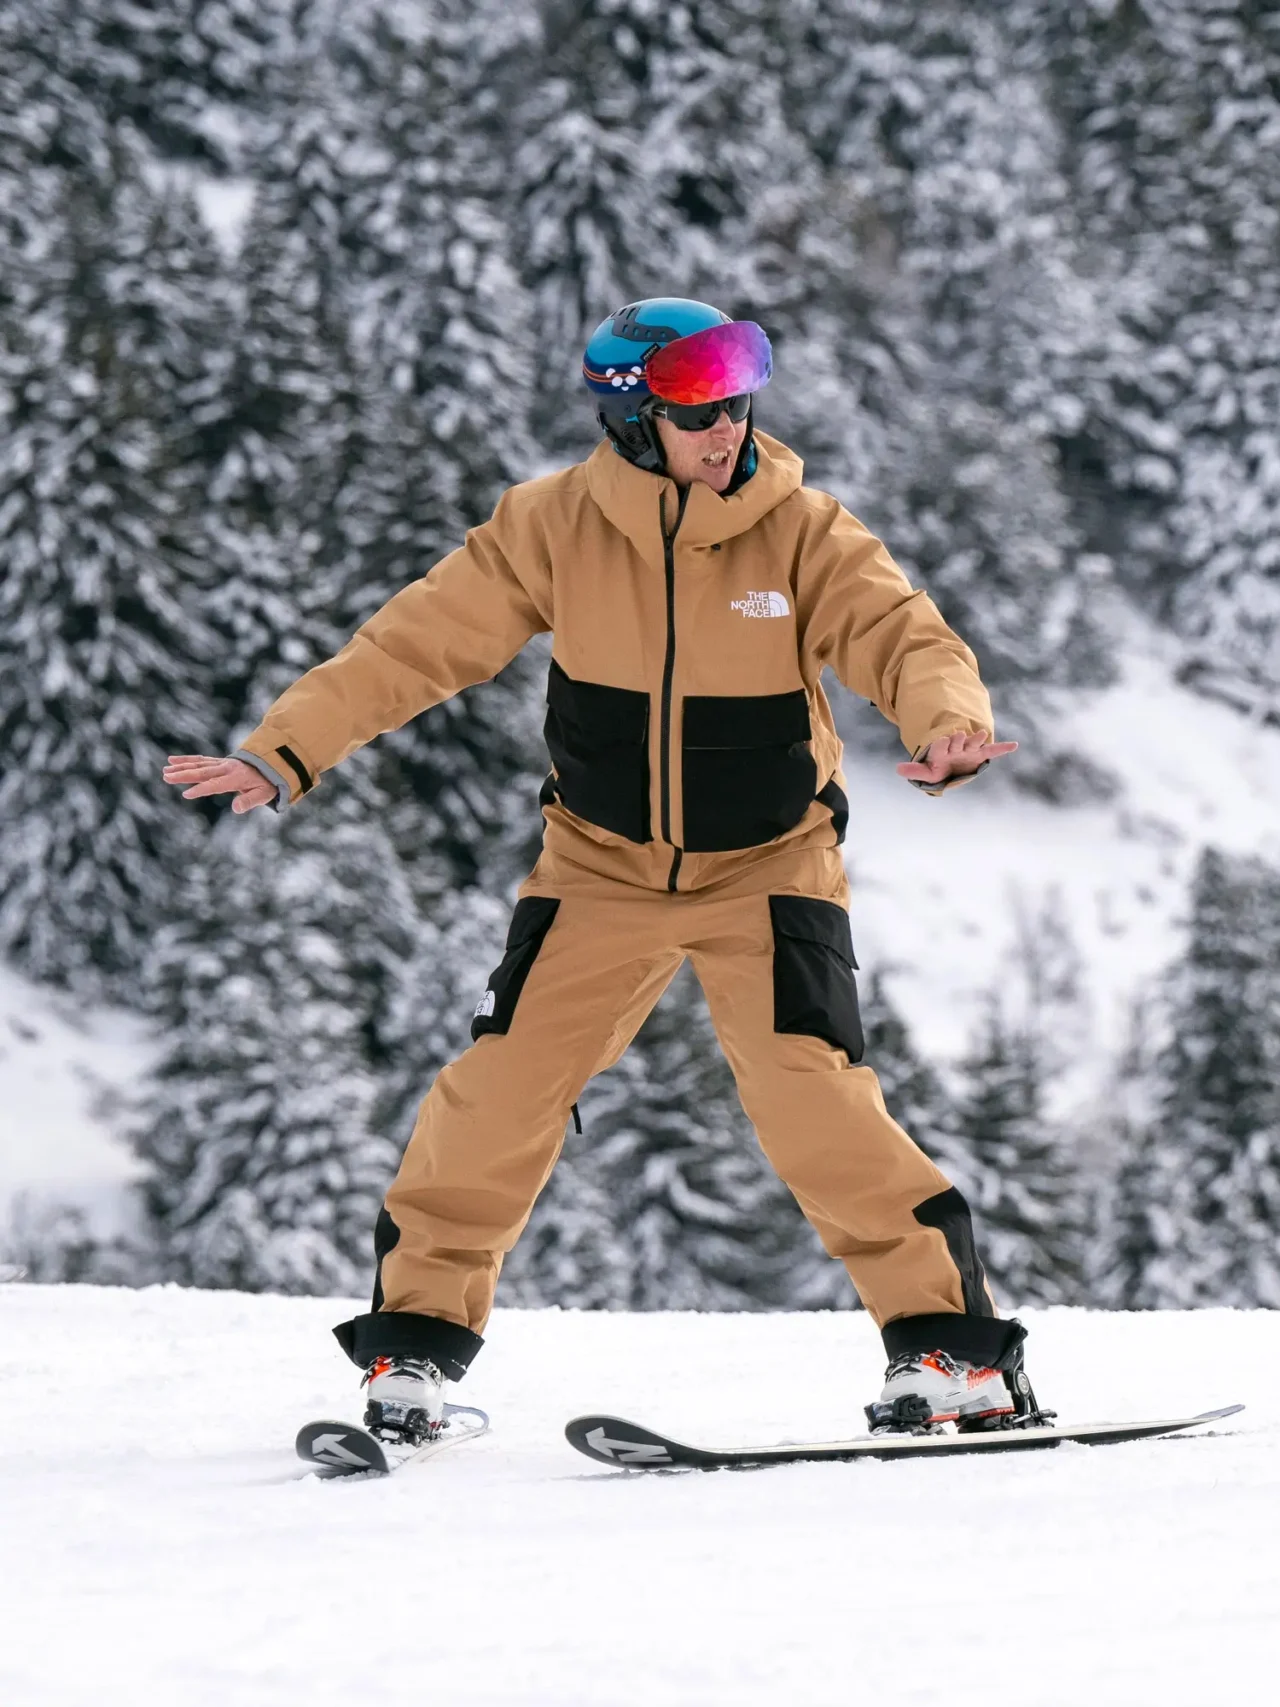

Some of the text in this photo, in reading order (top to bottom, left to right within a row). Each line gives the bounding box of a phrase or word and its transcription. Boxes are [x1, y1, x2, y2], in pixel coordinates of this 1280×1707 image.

[747, 591, 768, 601] THE
[731, 600, 769, 610] NORTH
[743, 609, 770, 618] FACE
